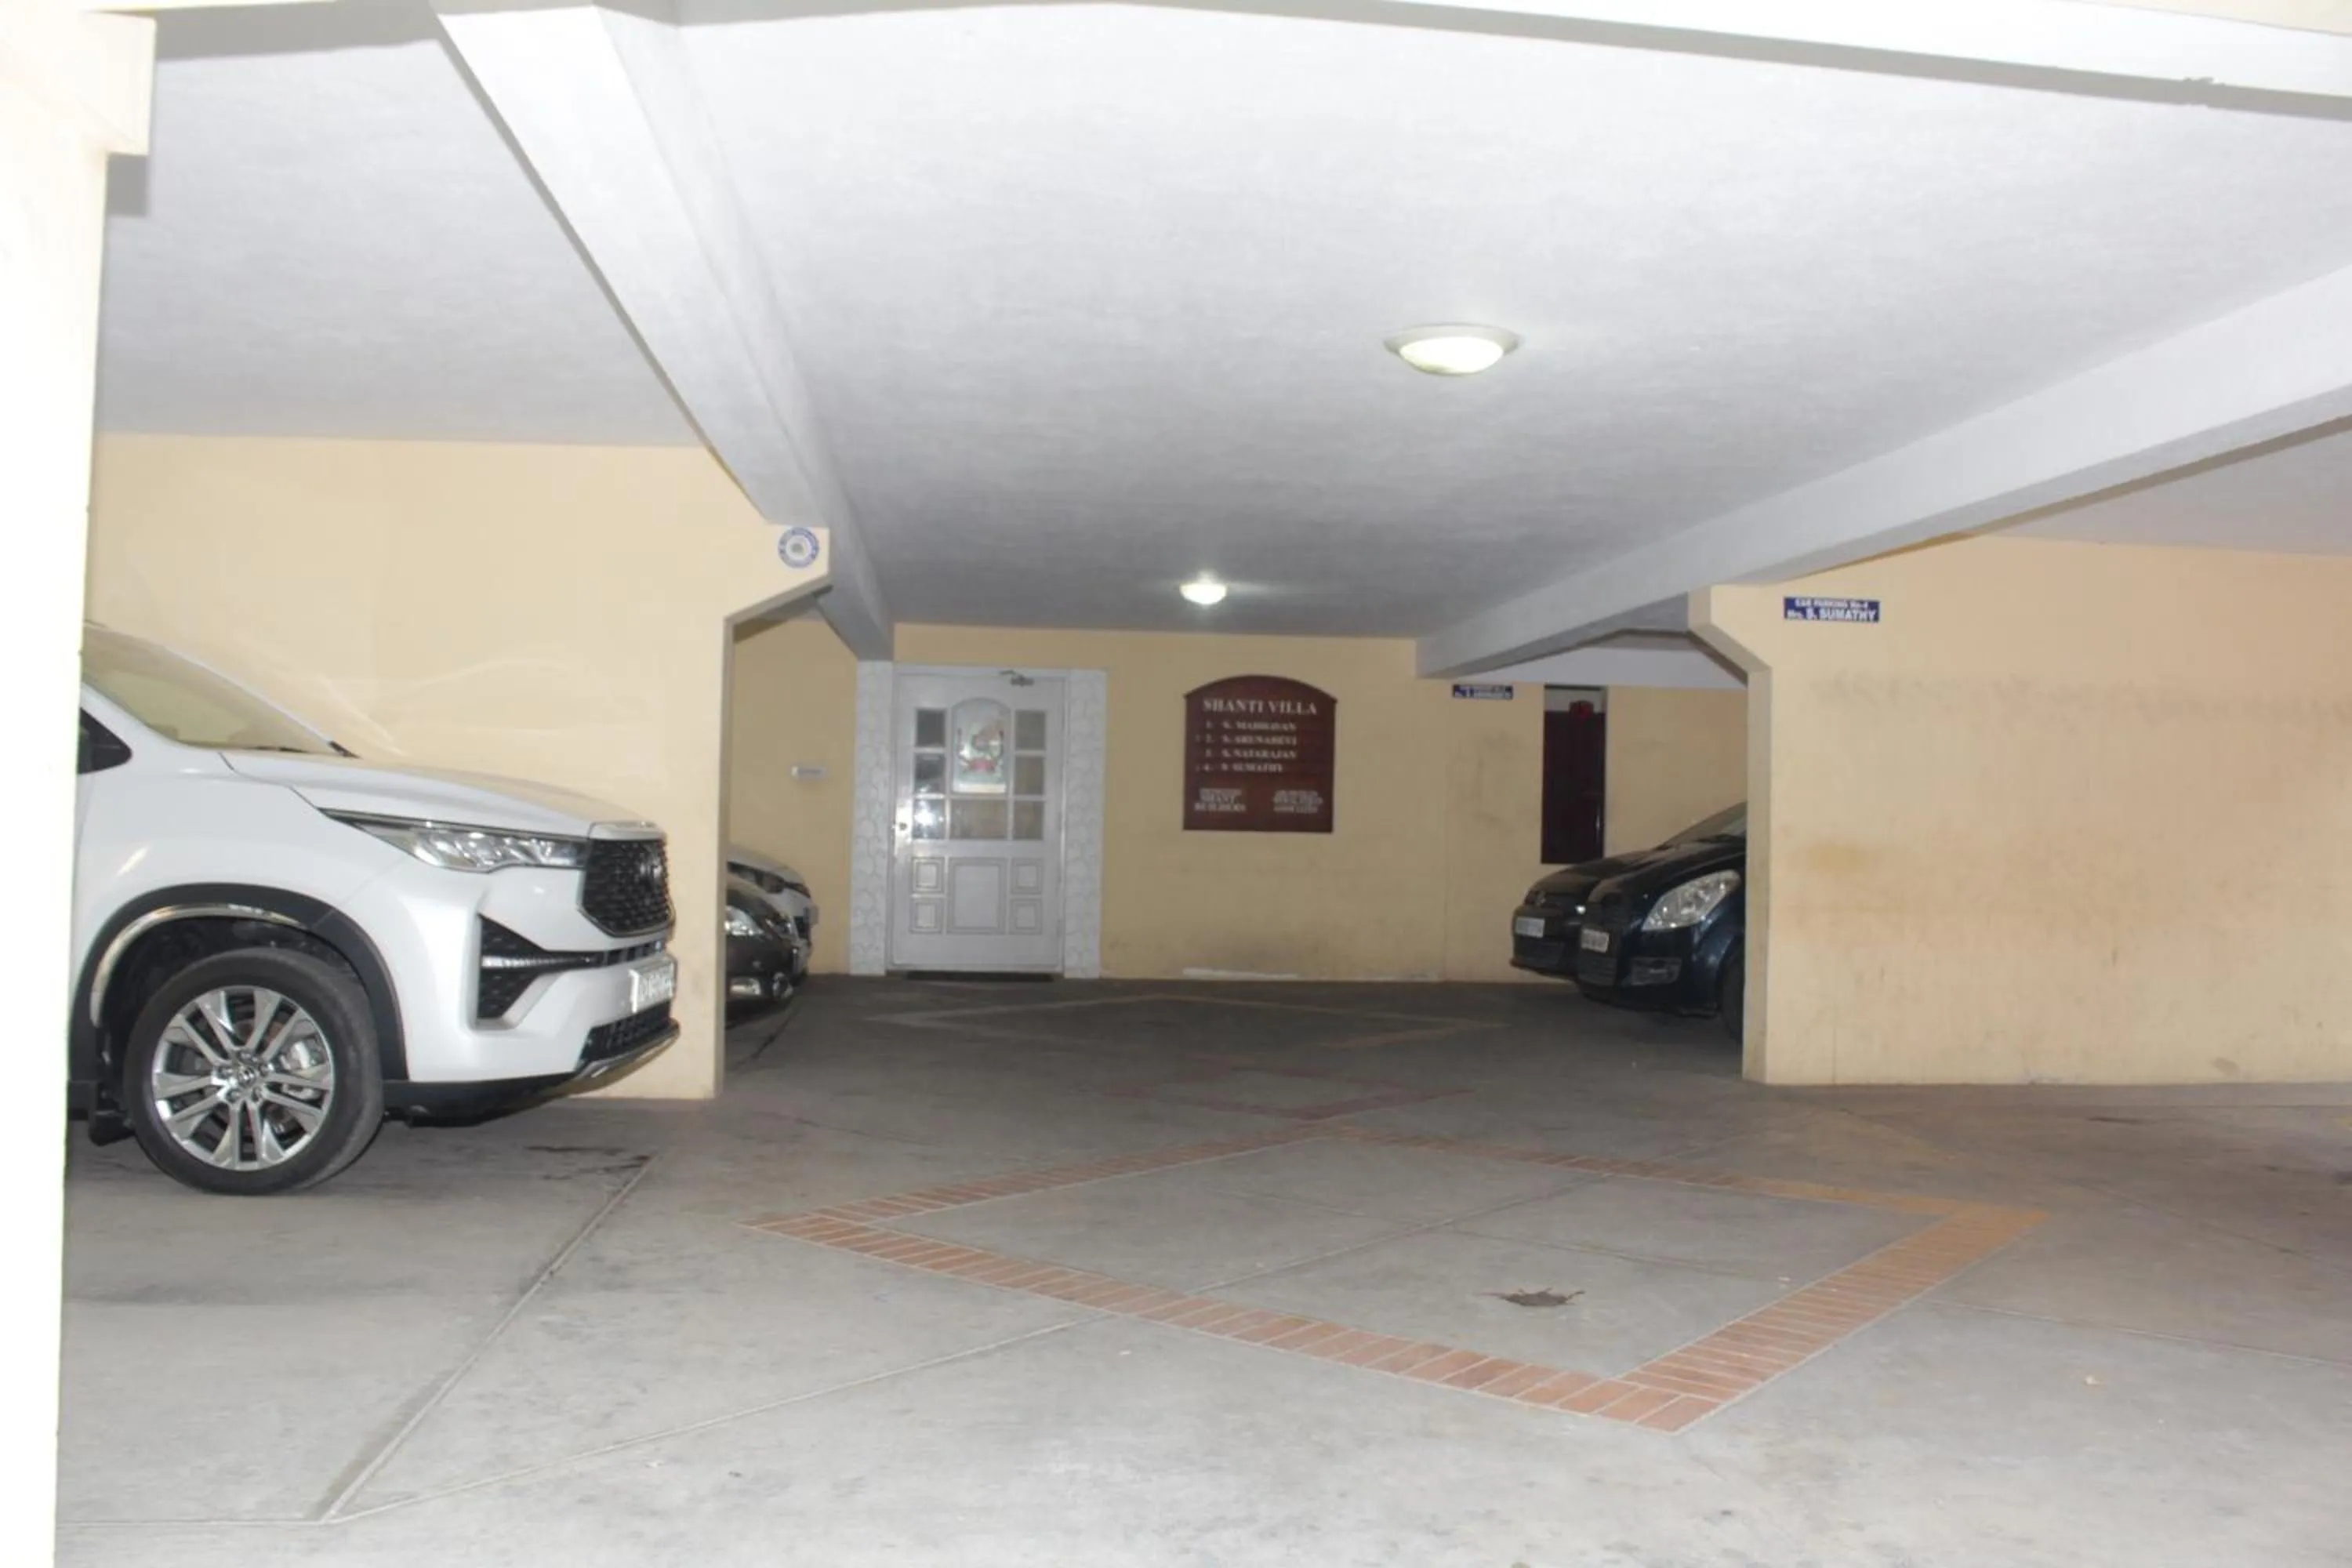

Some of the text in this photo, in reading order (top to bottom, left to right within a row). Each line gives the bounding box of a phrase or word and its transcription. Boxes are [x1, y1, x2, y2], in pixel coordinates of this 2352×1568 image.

[1819, 608, 1876, 622] SUMATHY
[1203, 699, 1317, 715] SHANTI VILLA
